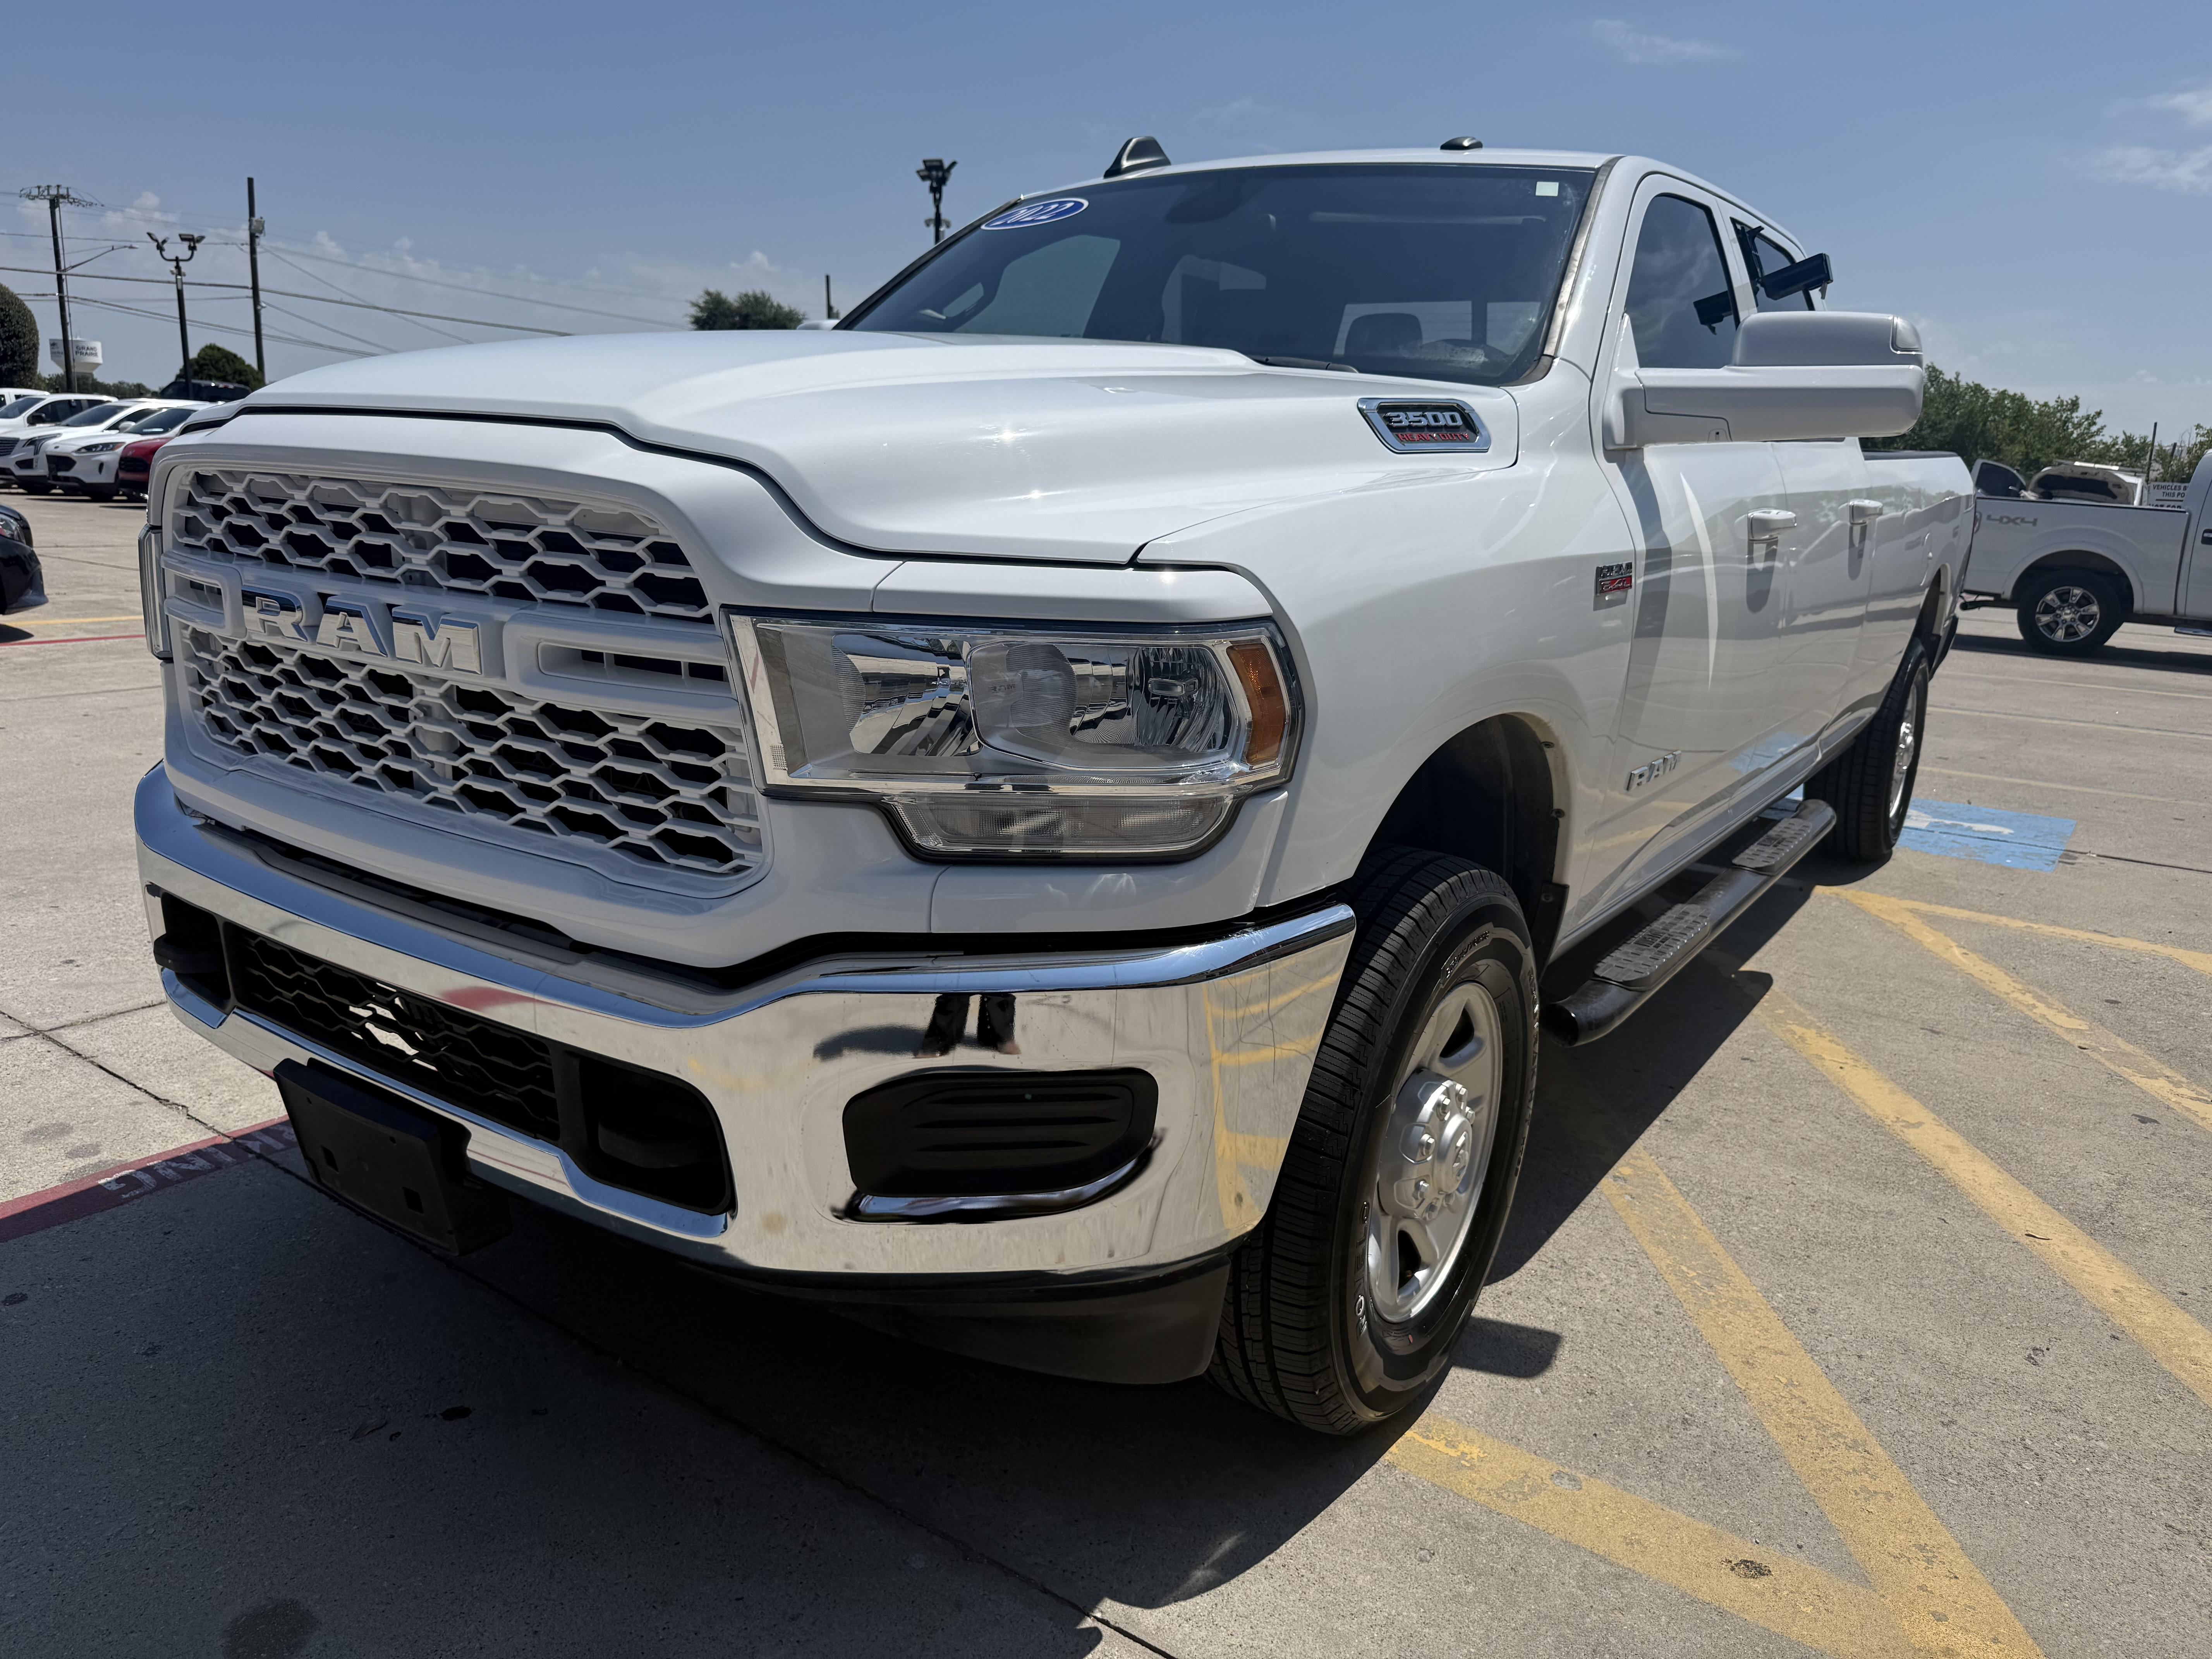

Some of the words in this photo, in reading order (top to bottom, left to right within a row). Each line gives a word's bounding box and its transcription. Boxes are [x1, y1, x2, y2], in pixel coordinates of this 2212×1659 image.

[989, 202, 1075, 226] 2022
[1382, 411, 1463, 426] 3500
[1396, 433, 1438, 441] HEAVY
[241, 584, 481, 675] RAM
[1625, 750, 1682, 792] RAM
[1354, 1201, 1369, 1338] ROVELO
